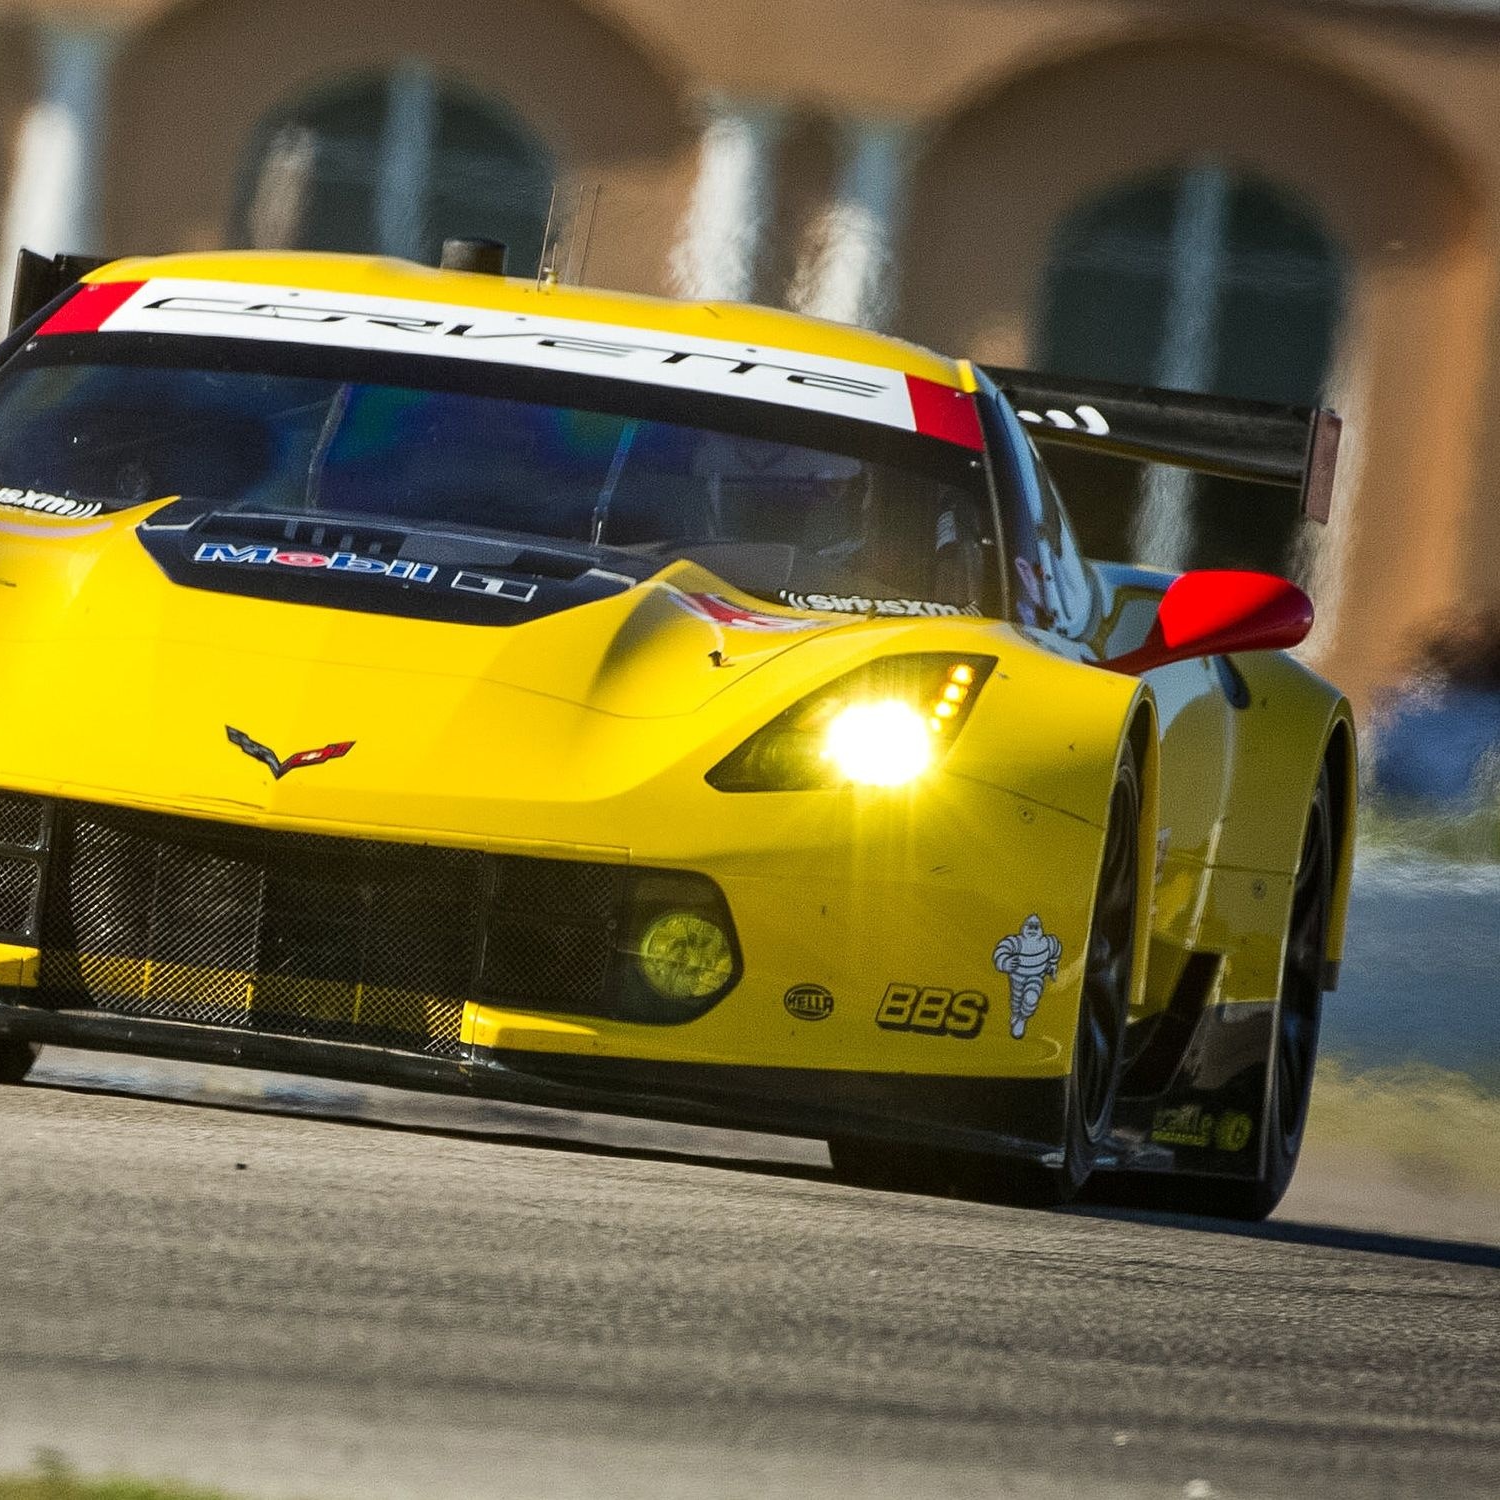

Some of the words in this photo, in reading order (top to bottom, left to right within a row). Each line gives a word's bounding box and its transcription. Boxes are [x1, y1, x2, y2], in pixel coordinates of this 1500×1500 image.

[142, 295, 891, 399] CORVETTE
[194, 542, 438, 583] Mobil
[785, 991, 835, 1015] HELLA
[874, 981, 990, 1040] BBS
